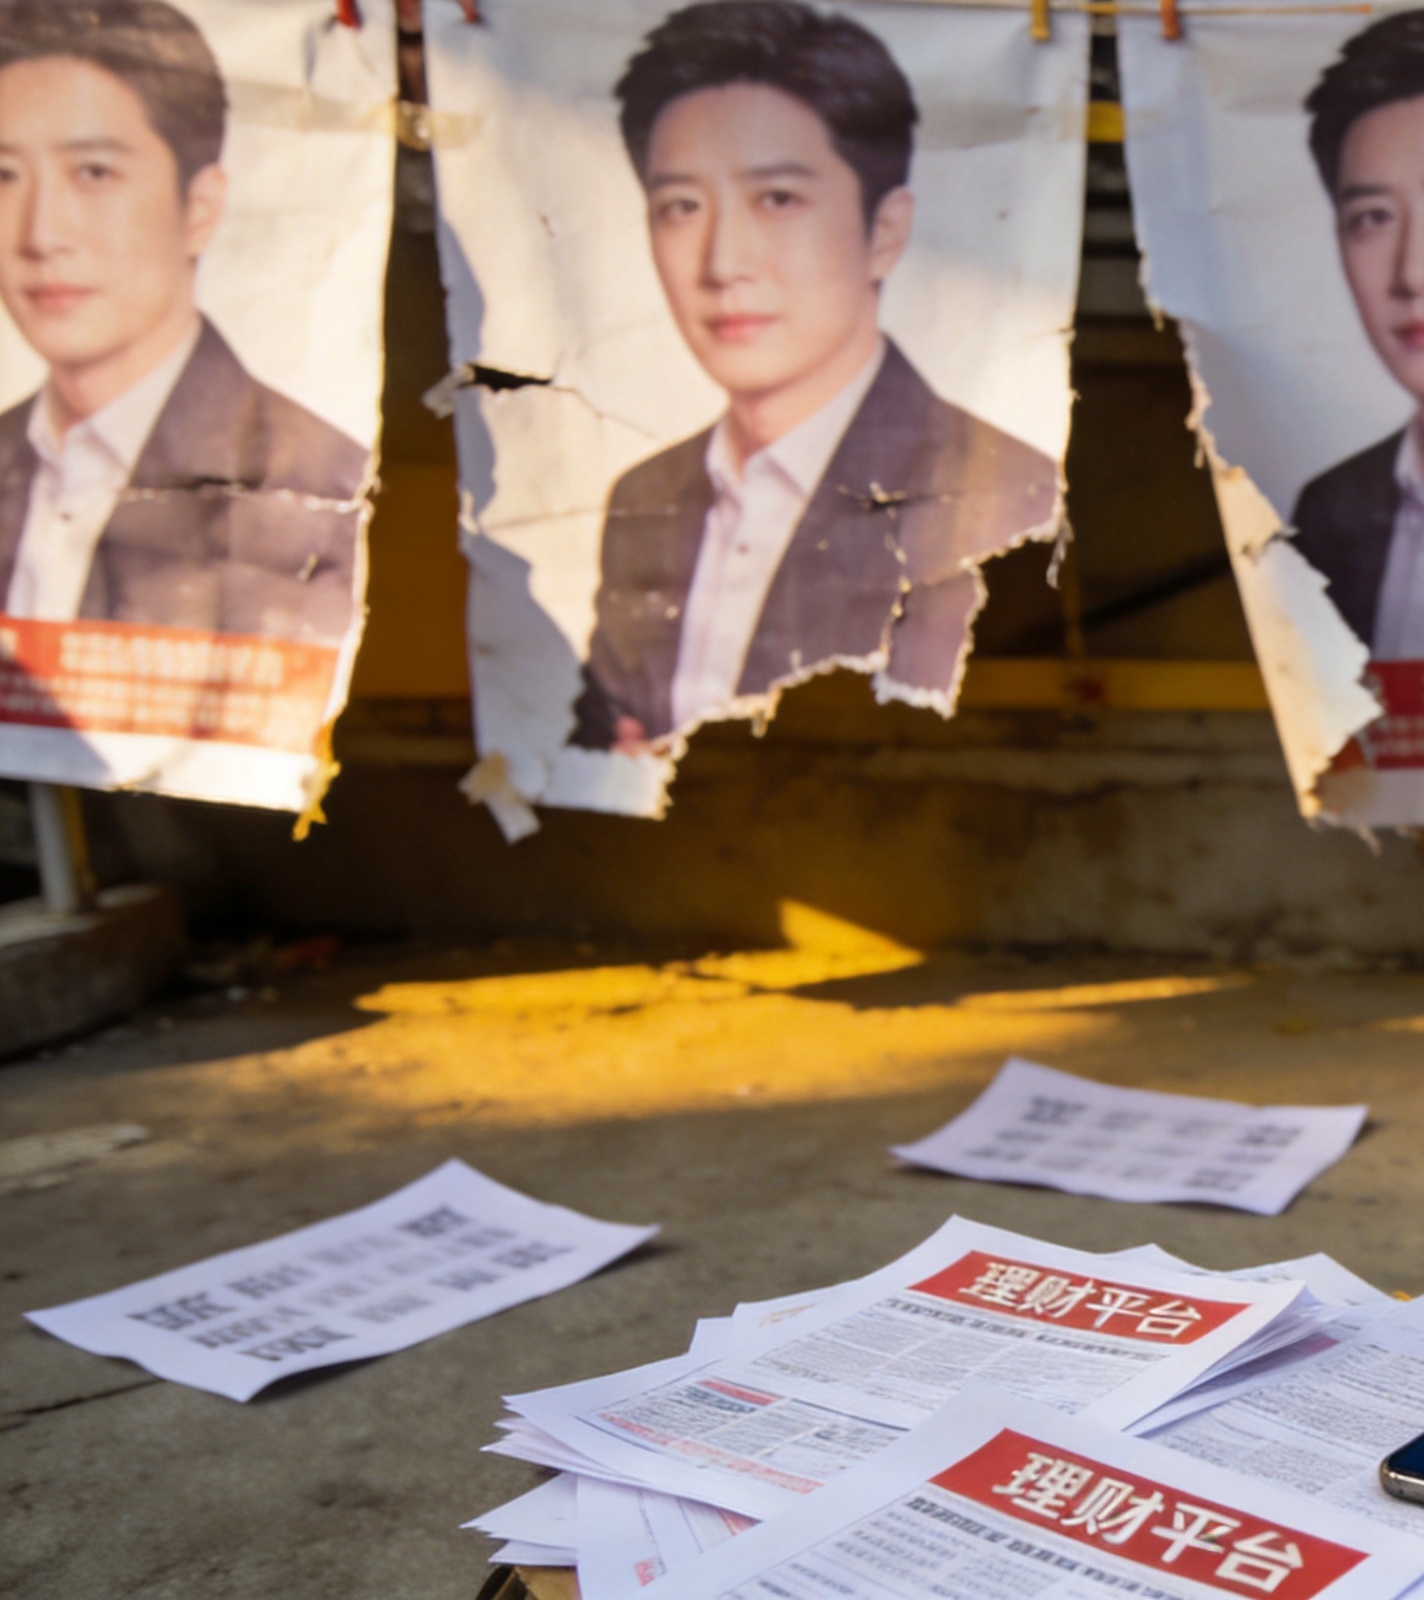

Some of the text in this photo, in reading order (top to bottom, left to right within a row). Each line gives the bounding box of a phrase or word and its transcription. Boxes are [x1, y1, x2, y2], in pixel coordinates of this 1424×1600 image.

[958, 1261, 1202, 1339] 理财平台
[992, 1452, 1304, 1593] 理财平台
